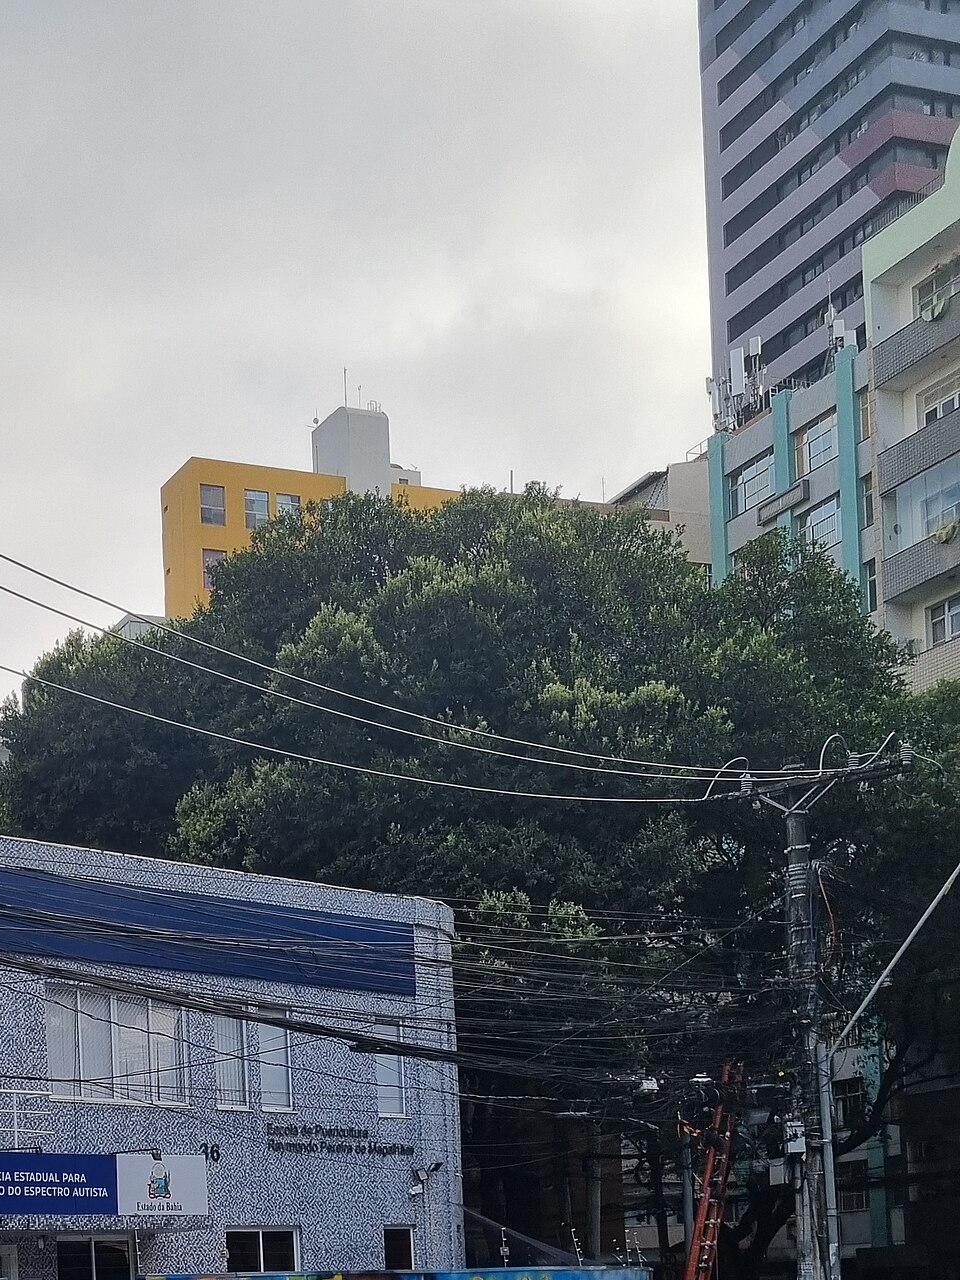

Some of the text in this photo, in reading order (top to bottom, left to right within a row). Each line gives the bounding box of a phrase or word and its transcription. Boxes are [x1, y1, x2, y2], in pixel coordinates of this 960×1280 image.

[14, 1171, 60, 1183] ESTADUAL
[62, 1173, 87, 1183] PARA
[7, 1186, 21, 1196] DO
[24, 1186, 70, 1197] ESPECTRO
[72, 1187, 108, 1198] AUTISTA
[137, 1201, 156, 1211] Estado
[166, 1201, 183, 1211] Bahia
